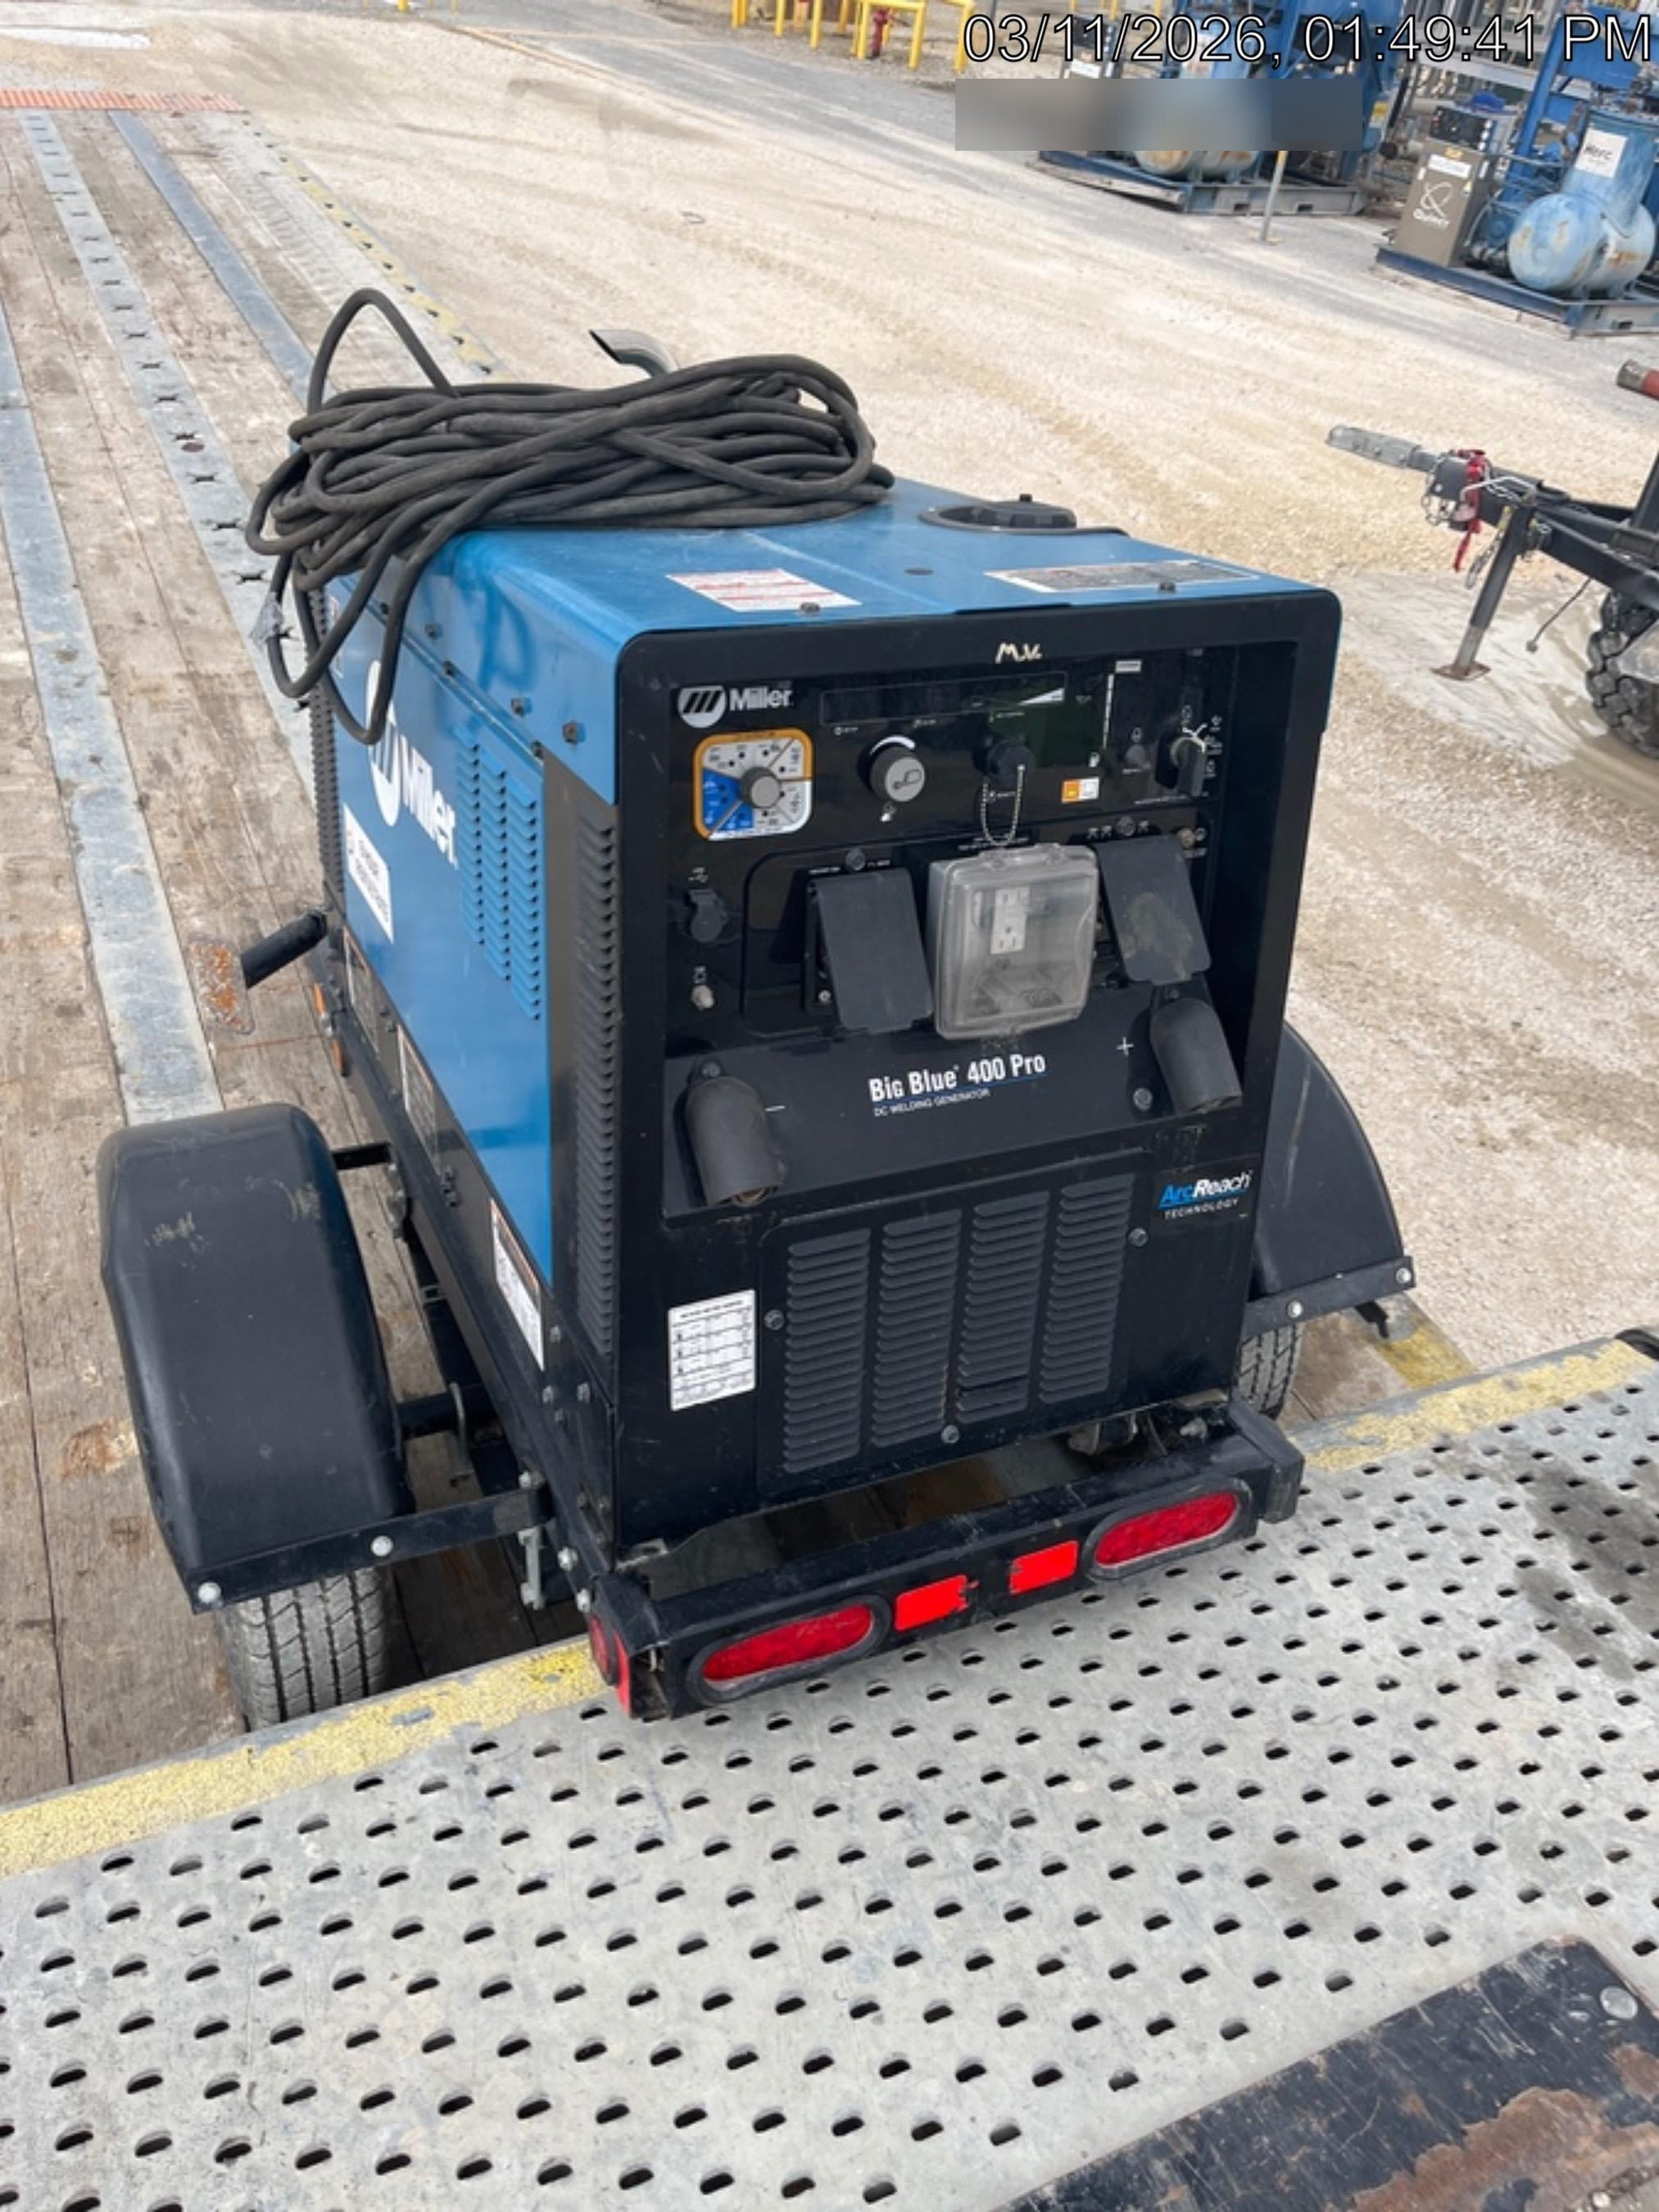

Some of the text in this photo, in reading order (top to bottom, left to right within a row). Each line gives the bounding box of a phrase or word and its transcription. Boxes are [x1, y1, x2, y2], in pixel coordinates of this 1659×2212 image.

[729, 685, 794, 711] Miller
[400, 734, 457, 866] Miller
[967, 1056, 1006, 1084] 400
[1009, 1053, 1046, 1077] Pro
[873, 1106, 889, 1117] DC
[890, 1097, 932, 1115] WELDING
